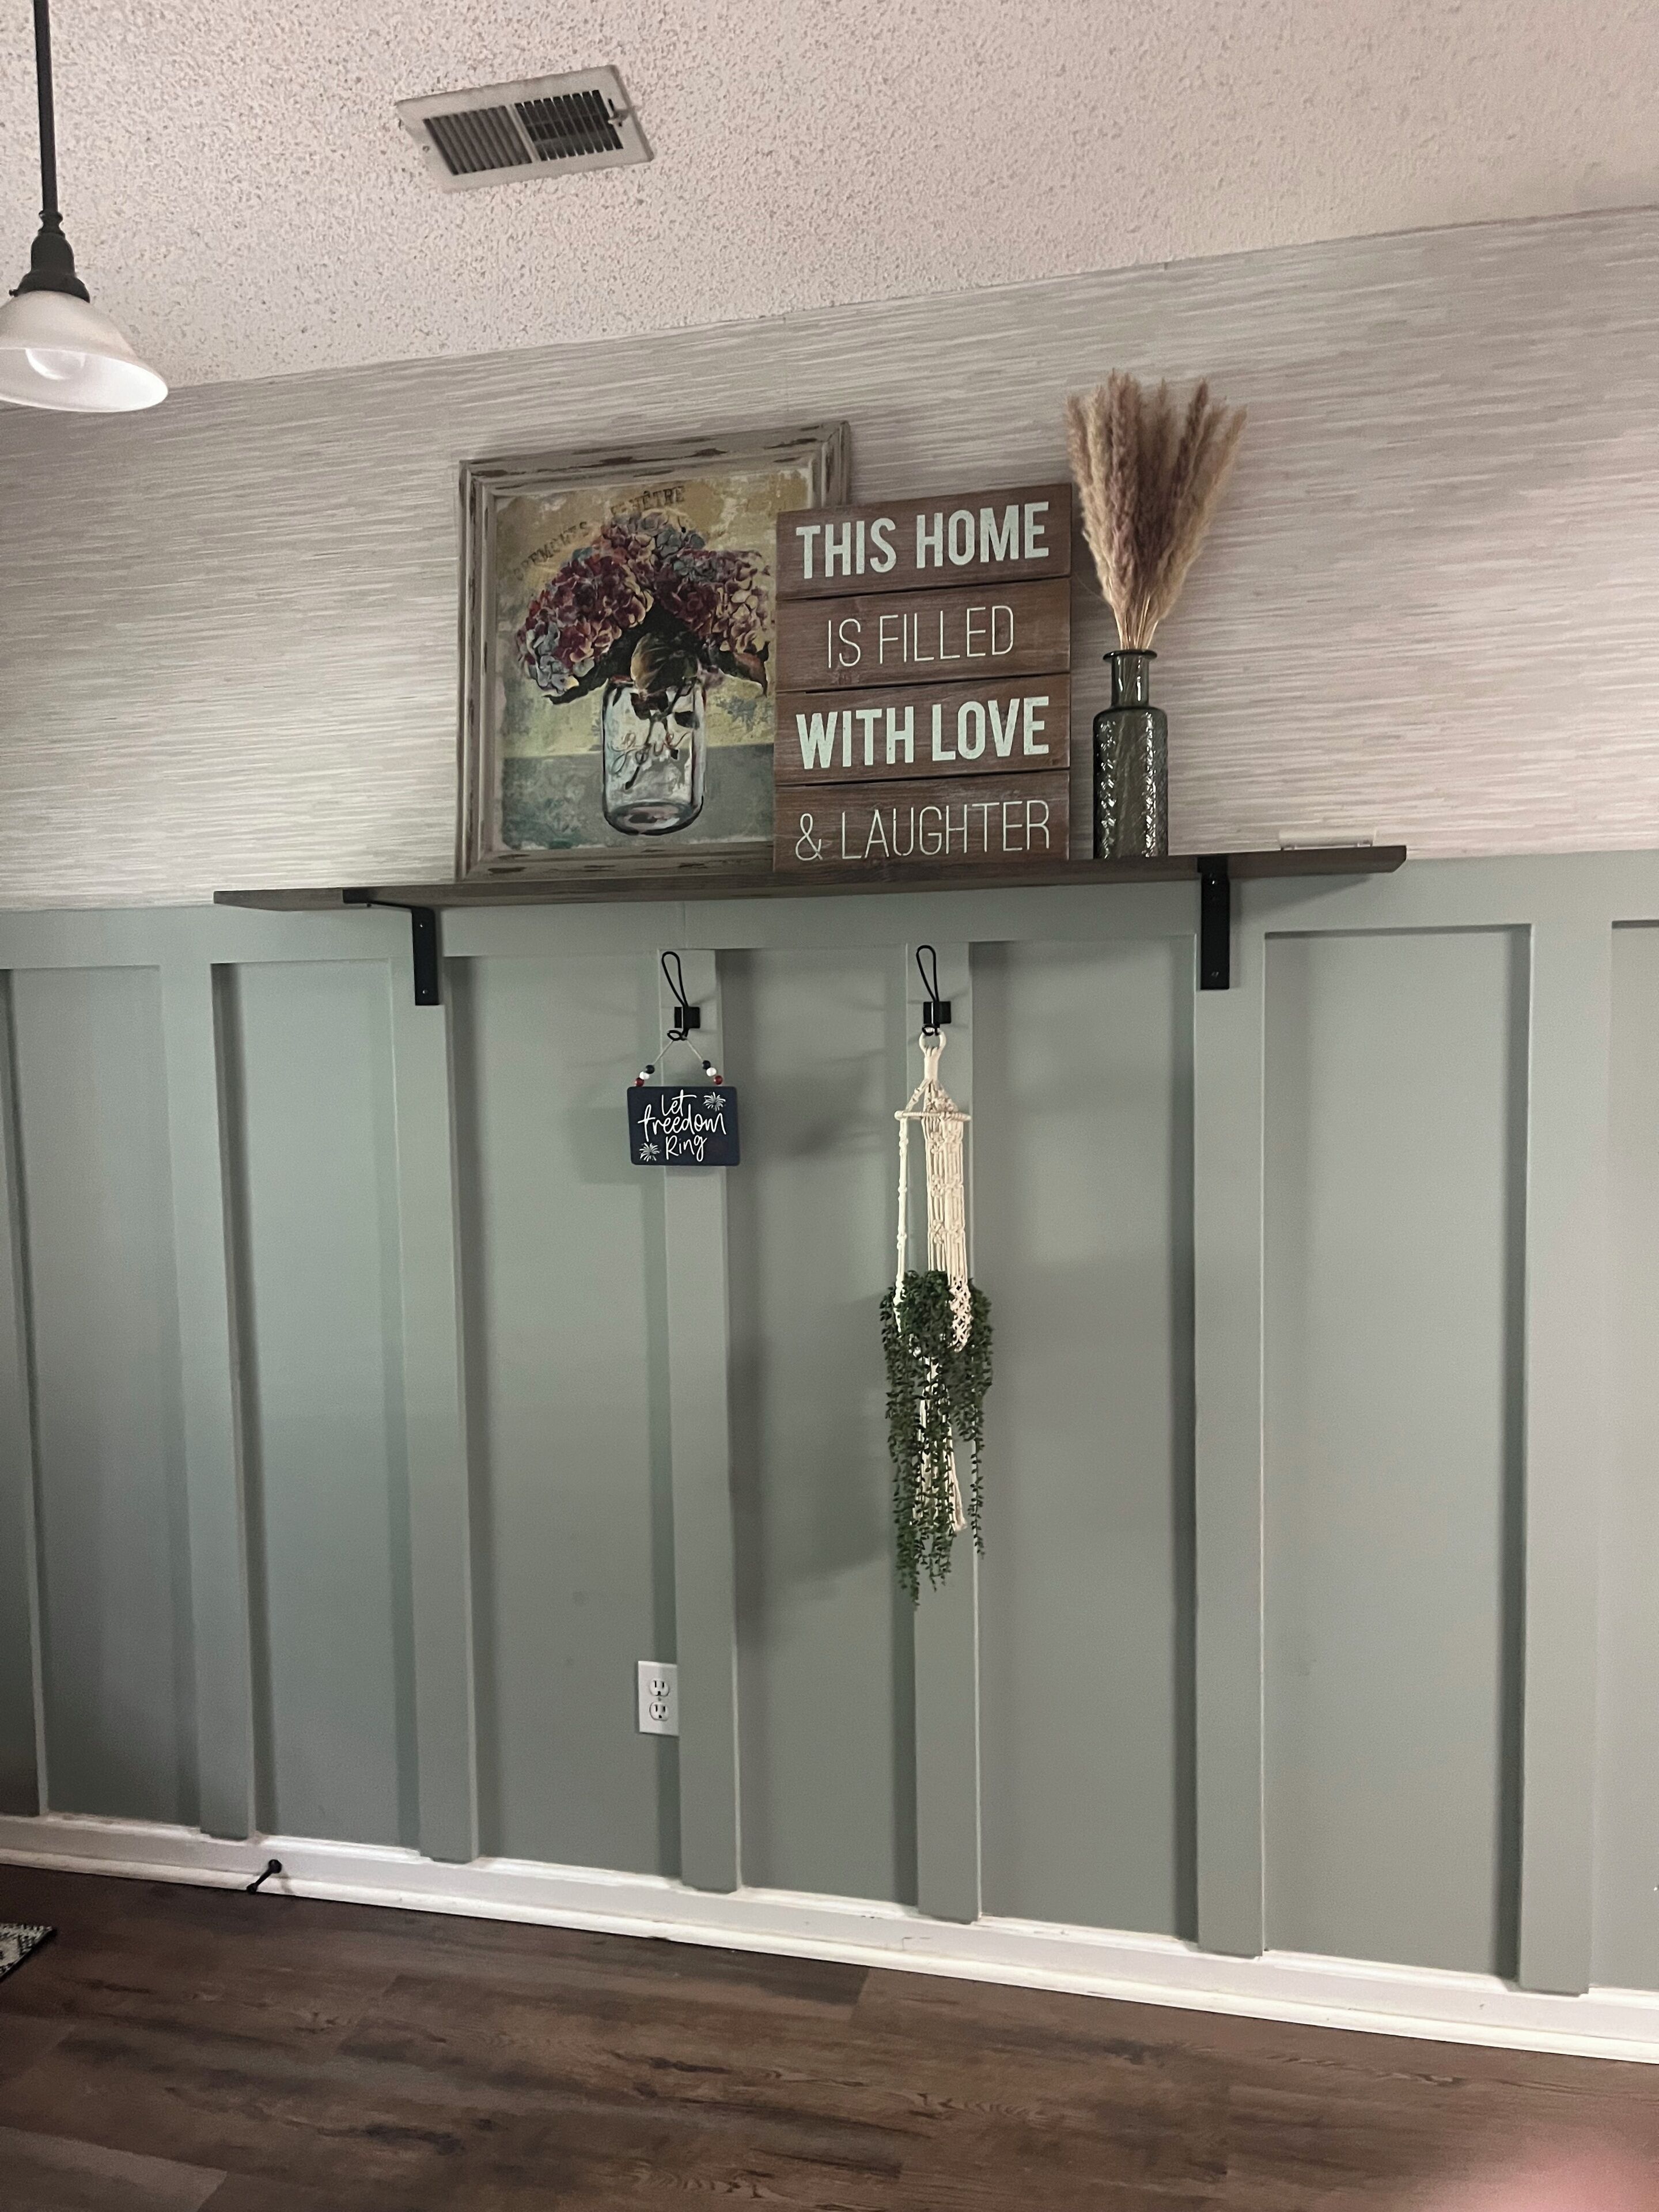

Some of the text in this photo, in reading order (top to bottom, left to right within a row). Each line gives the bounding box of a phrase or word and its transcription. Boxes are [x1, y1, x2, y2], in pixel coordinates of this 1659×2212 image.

[796, 501, 1050, 579] THIS HOME
[828, 605, 1014, 668] IS FILLED
[796, 696, 1050, 770] WITH LOVE
[795, 800, 1050, 861] & LAUGHTER
[637, 1104, 726, 1142] freedom
[665, 1134, 707, 1162] Ring
